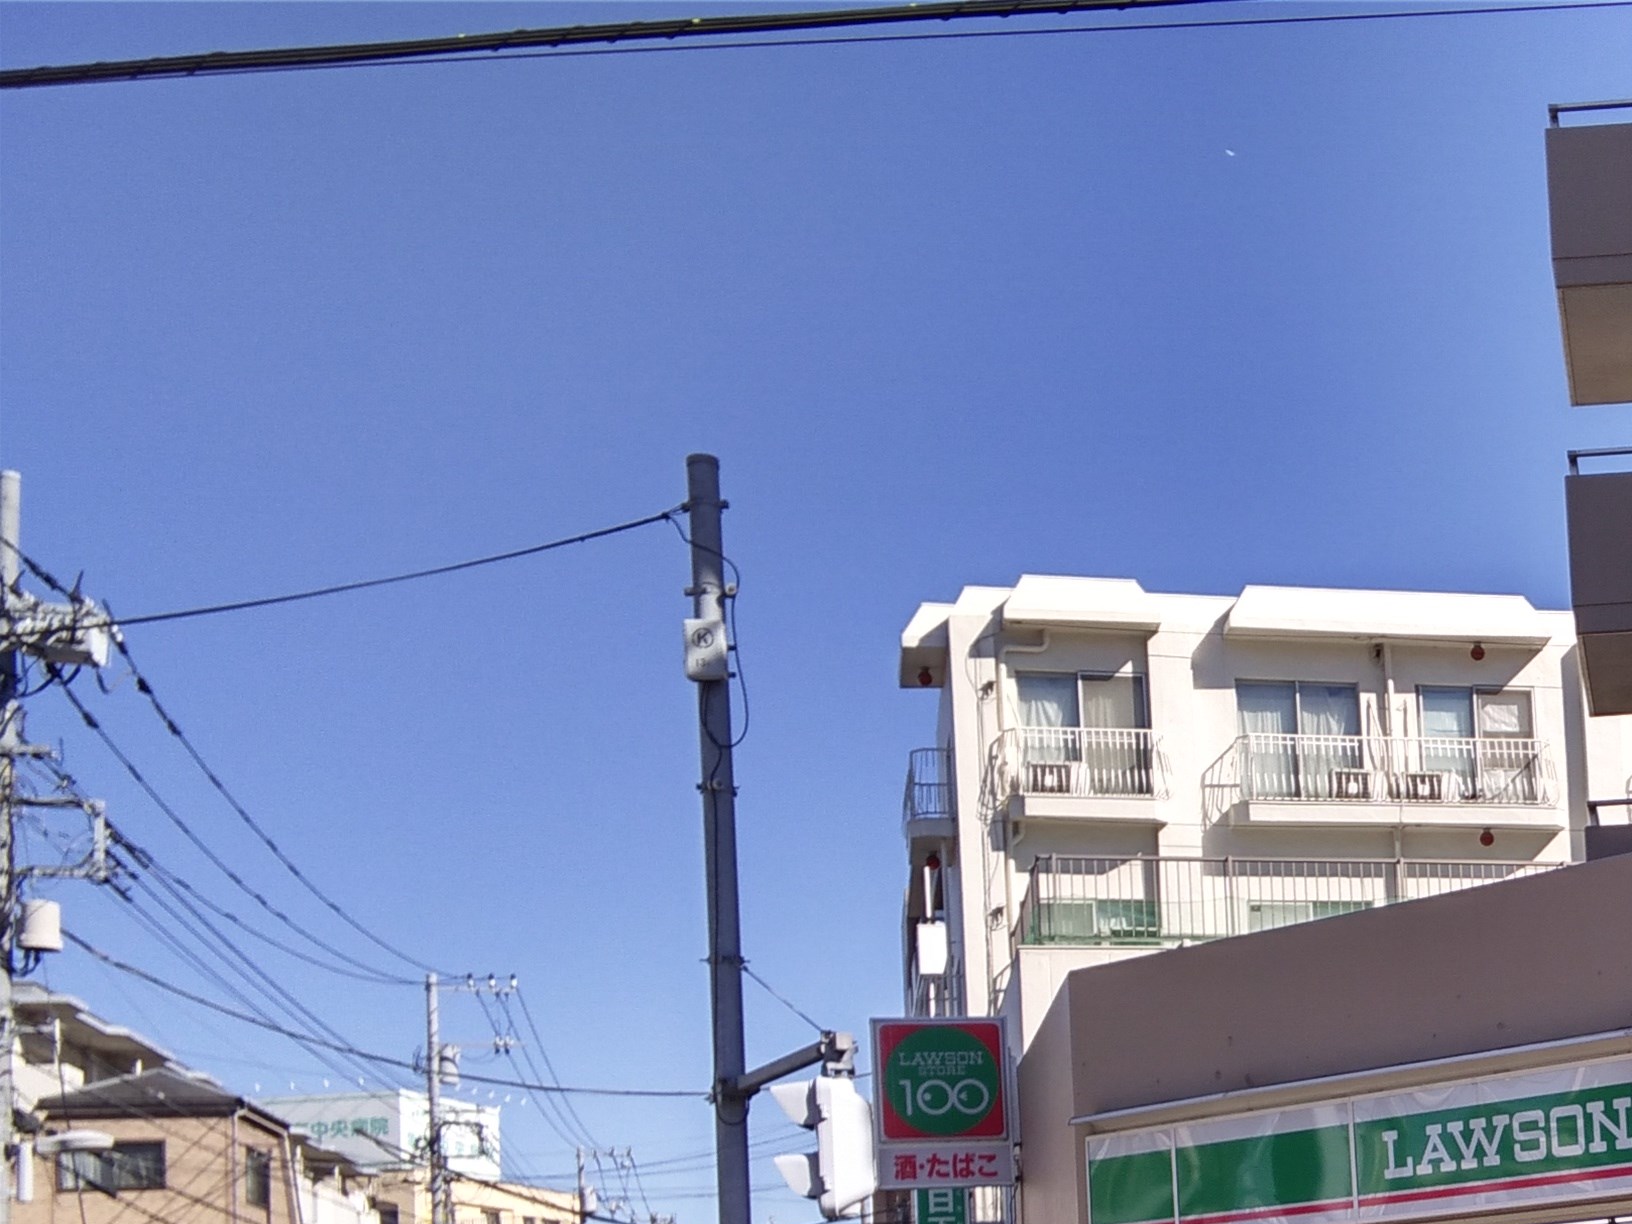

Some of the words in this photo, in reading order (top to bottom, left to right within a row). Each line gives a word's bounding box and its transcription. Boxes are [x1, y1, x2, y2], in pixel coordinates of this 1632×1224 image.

[899, 1052, 983, 1065] LAWSON
[919, 1066, 966, 1076] STORE
[899, 1079, 989, 1116] 100
